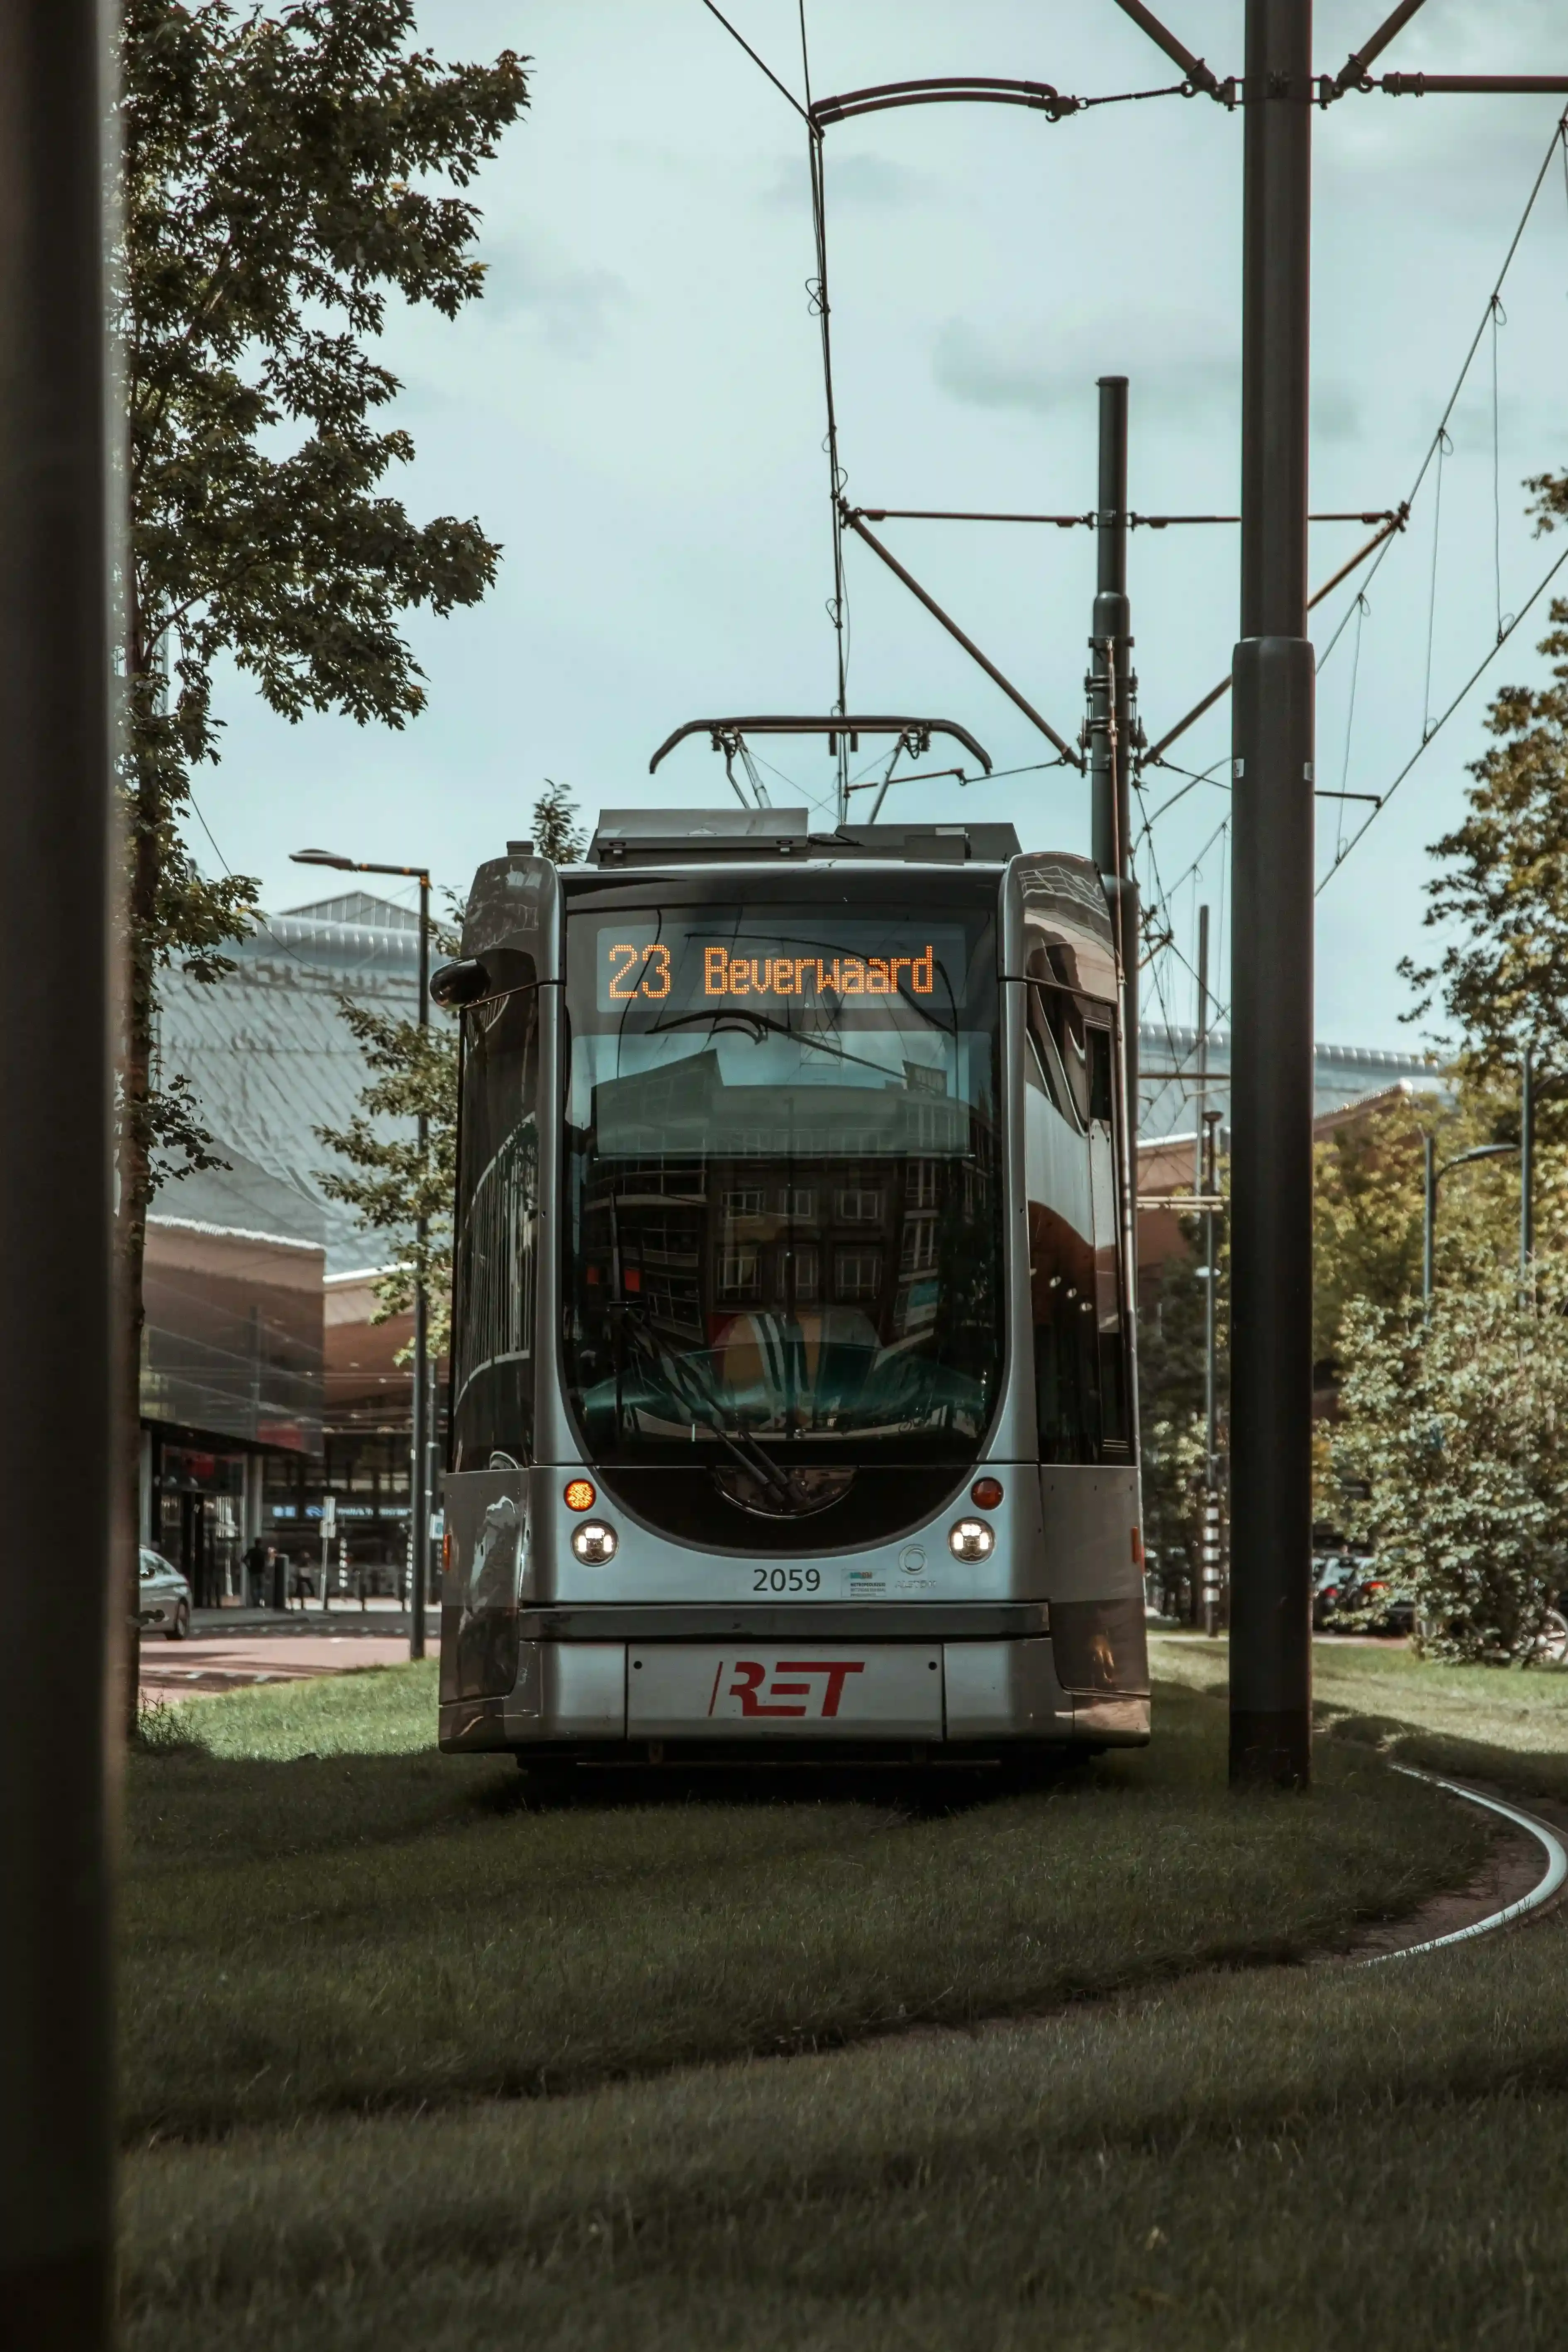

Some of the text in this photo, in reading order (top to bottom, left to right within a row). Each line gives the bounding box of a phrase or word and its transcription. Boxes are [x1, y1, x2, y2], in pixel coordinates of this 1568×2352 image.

[609, 944, 933, 998] 23 Beverwaard
[753, 1569, 821, 1592] 2059
[729, 1662, 866, 1717] RET
